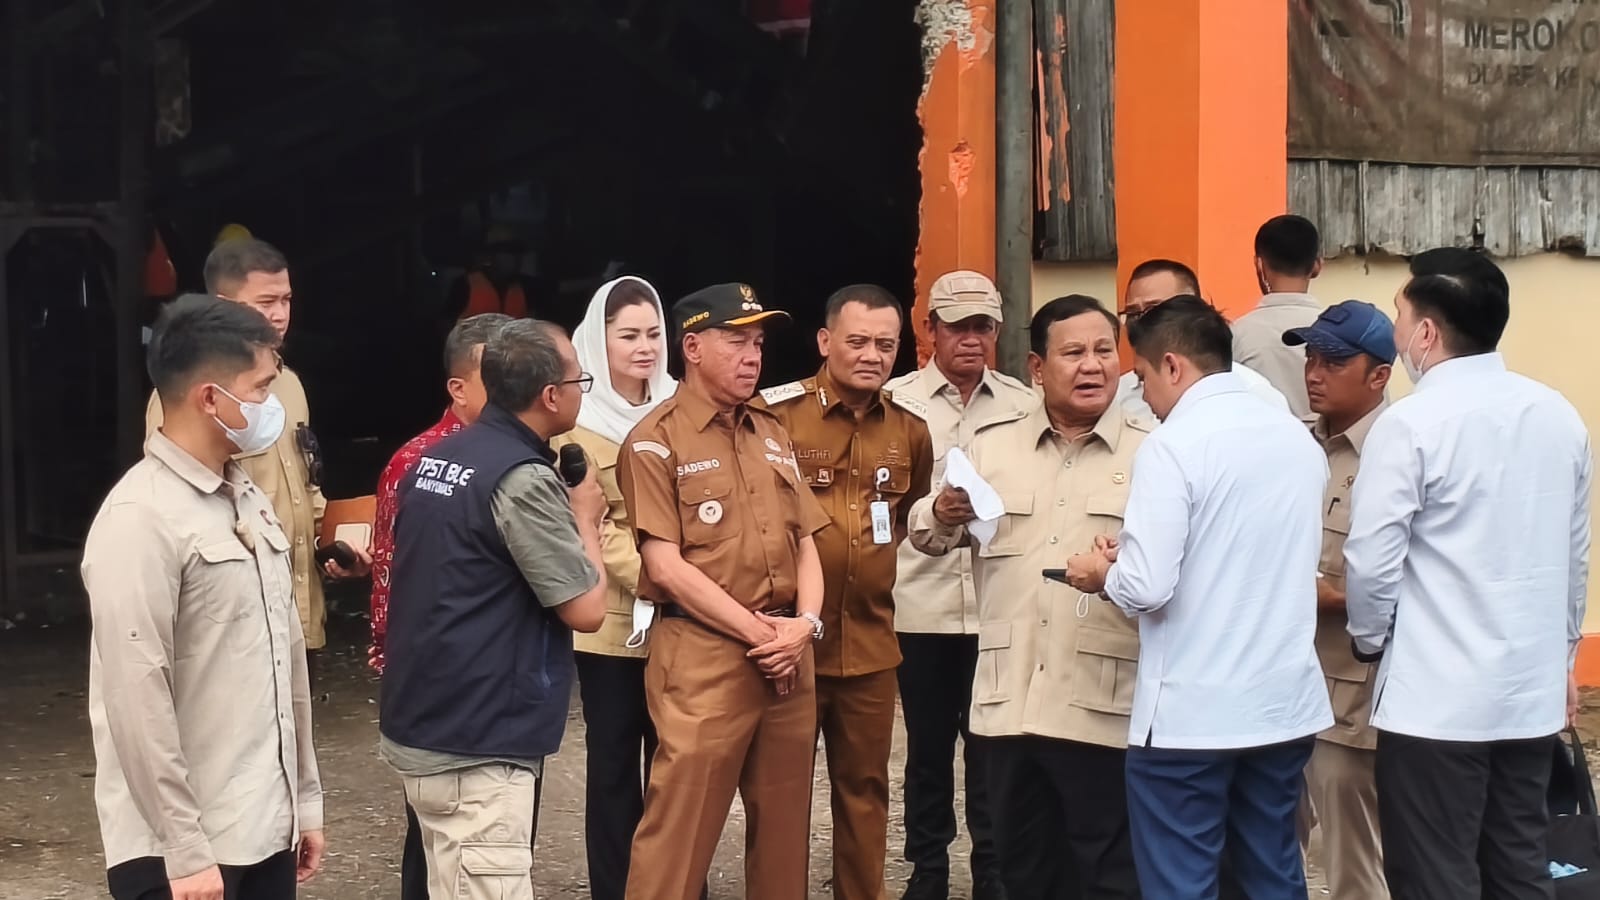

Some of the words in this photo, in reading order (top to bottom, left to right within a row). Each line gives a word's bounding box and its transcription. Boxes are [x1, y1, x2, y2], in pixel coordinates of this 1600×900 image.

[416, 456, 448, 479] TPST
[445, 463, 475, 487] BLE
[676, 458, 720, 476] SADEWO
